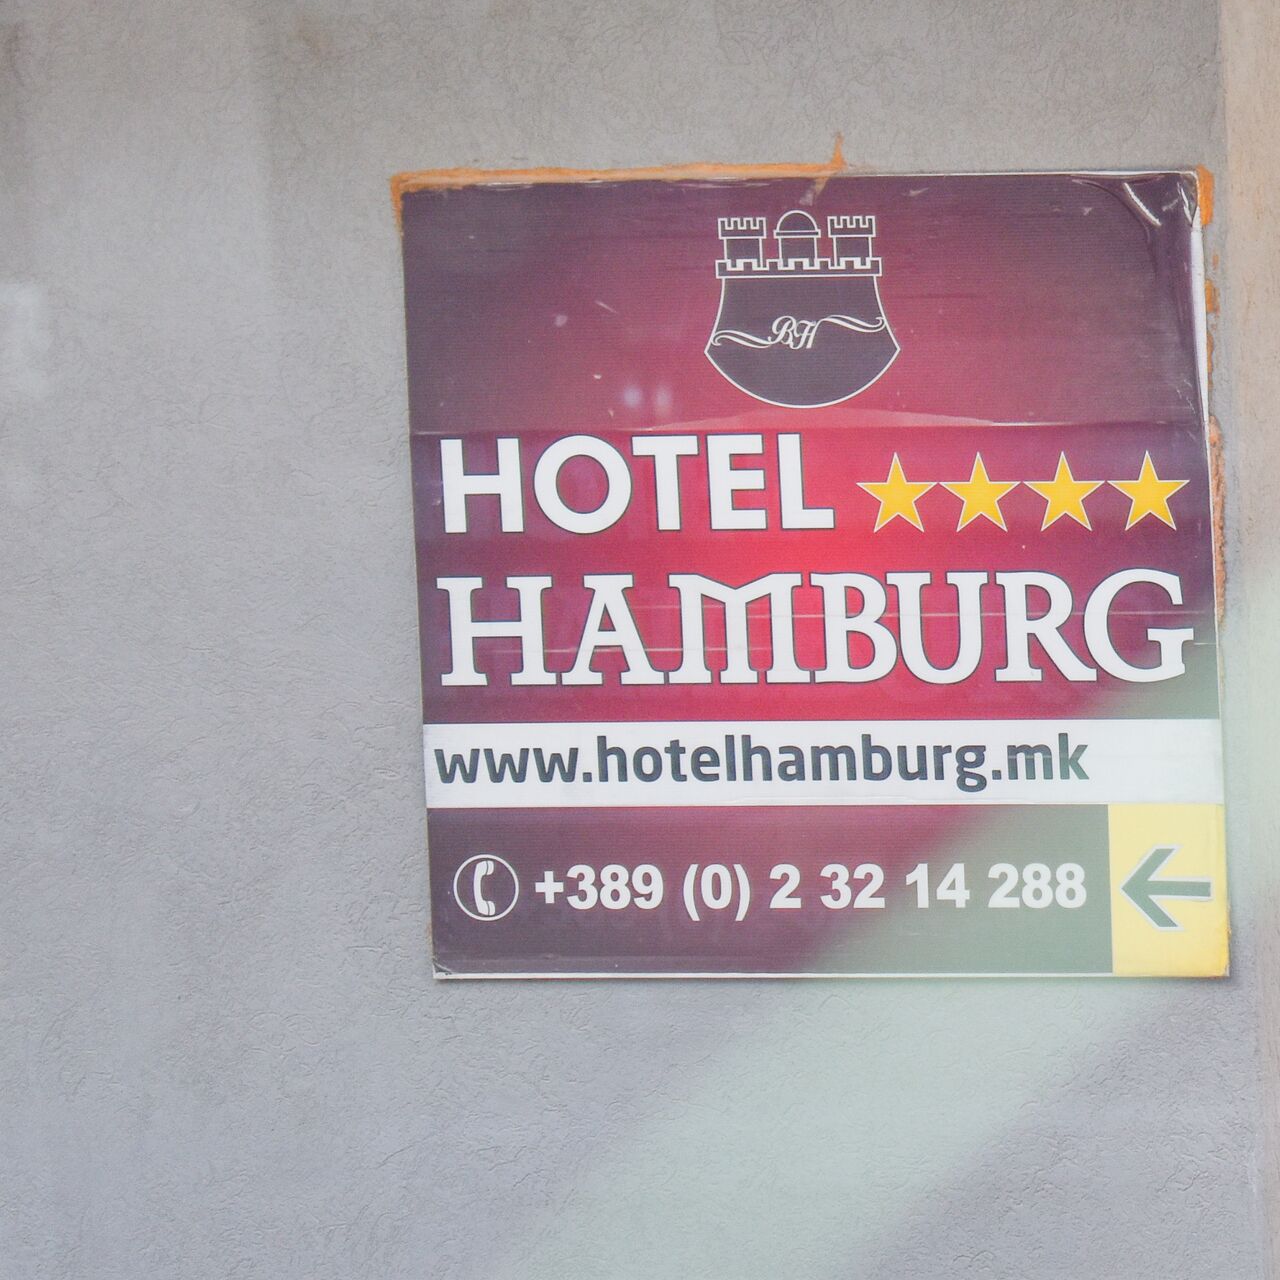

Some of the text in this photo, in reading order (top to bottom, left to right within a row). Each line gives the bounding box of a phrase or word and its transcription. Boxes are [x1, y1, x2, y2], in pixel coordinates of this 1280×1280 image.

[440, 434, 835, 534] HOTEL
[436, 568, 1195, 687] HAMBURG
[434, 732, 1090, 793] www.hotelhamburg.mk
[534, 862, 1087, 922] +389 (0) 2 32 14 288
